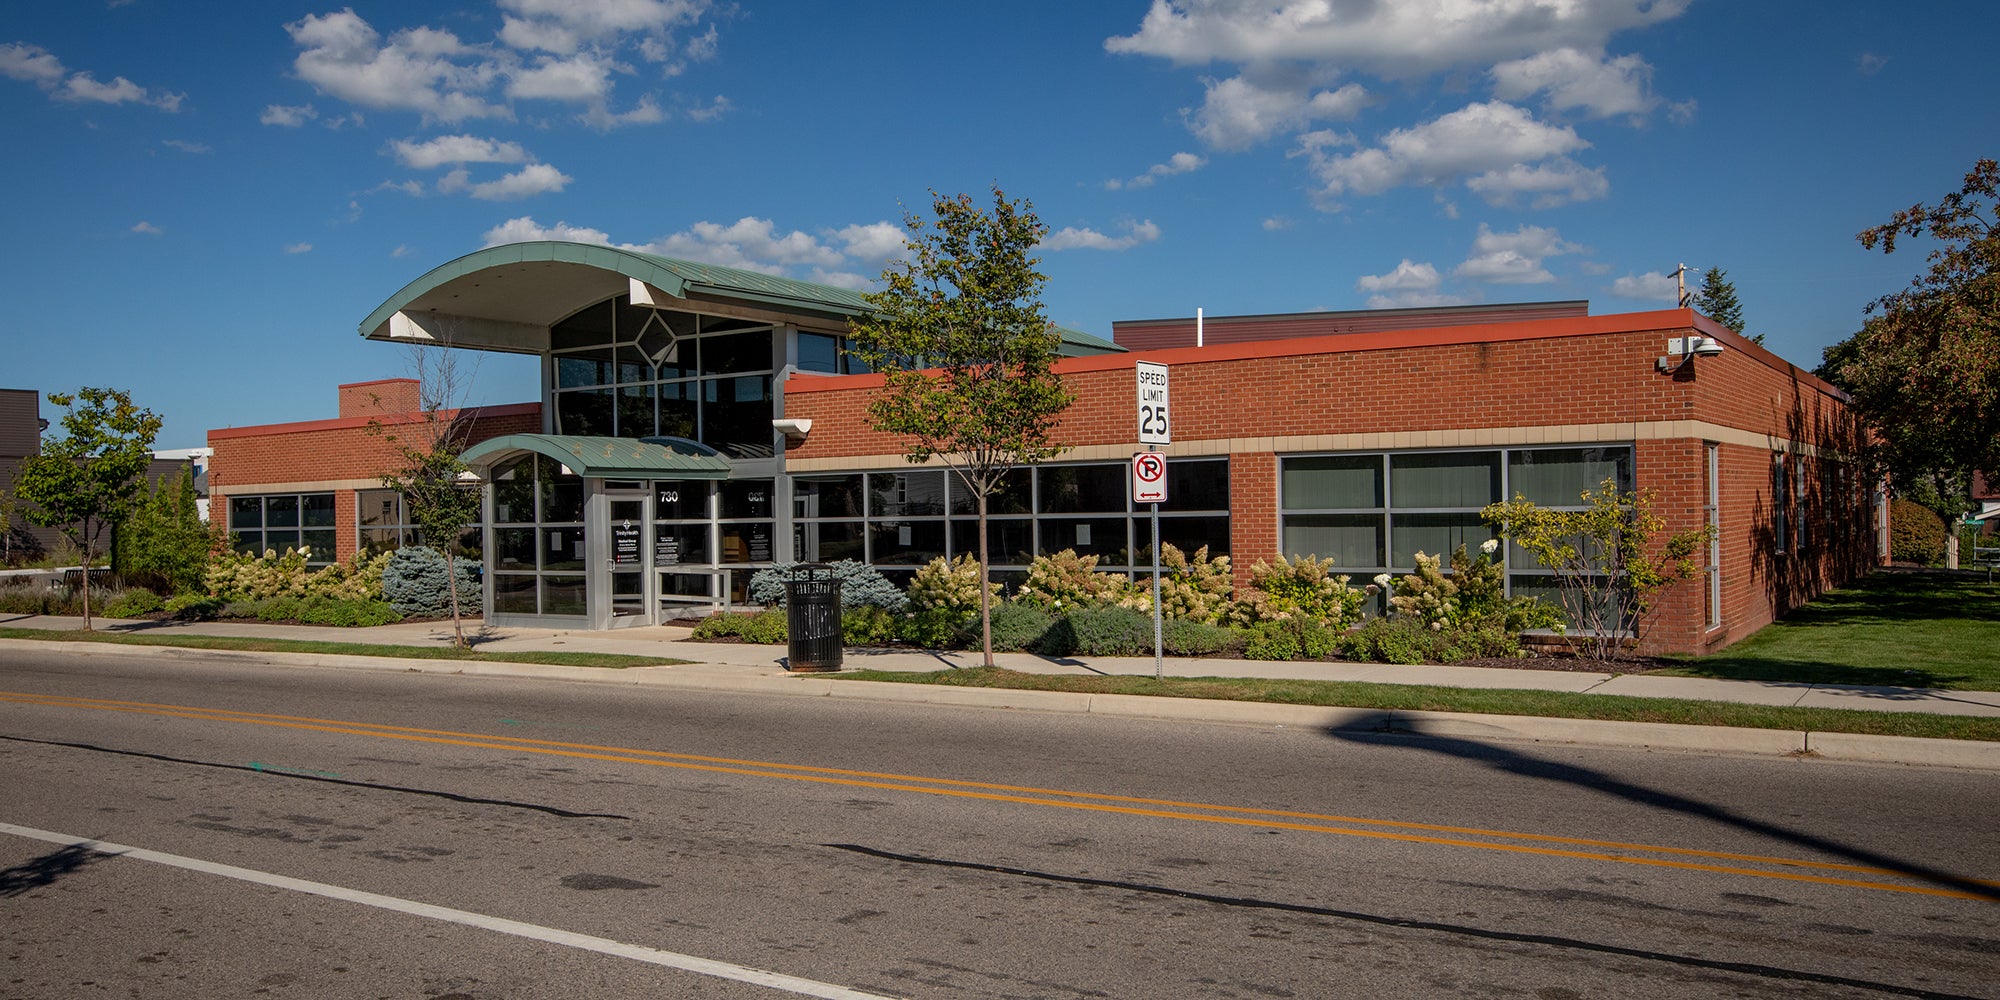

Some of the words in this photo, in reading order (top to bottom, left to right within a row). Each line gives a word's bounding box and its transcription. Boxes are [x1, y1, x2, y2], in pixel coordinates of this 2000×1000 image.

[1140, 371, 1166, 386] SPEED
[1143, 389, 1163, 402] LIMIT
[1141, 405, 1167, 435] 25
[1145, 460, 1158, 477] P
[660, 491, 679, 503] 730
